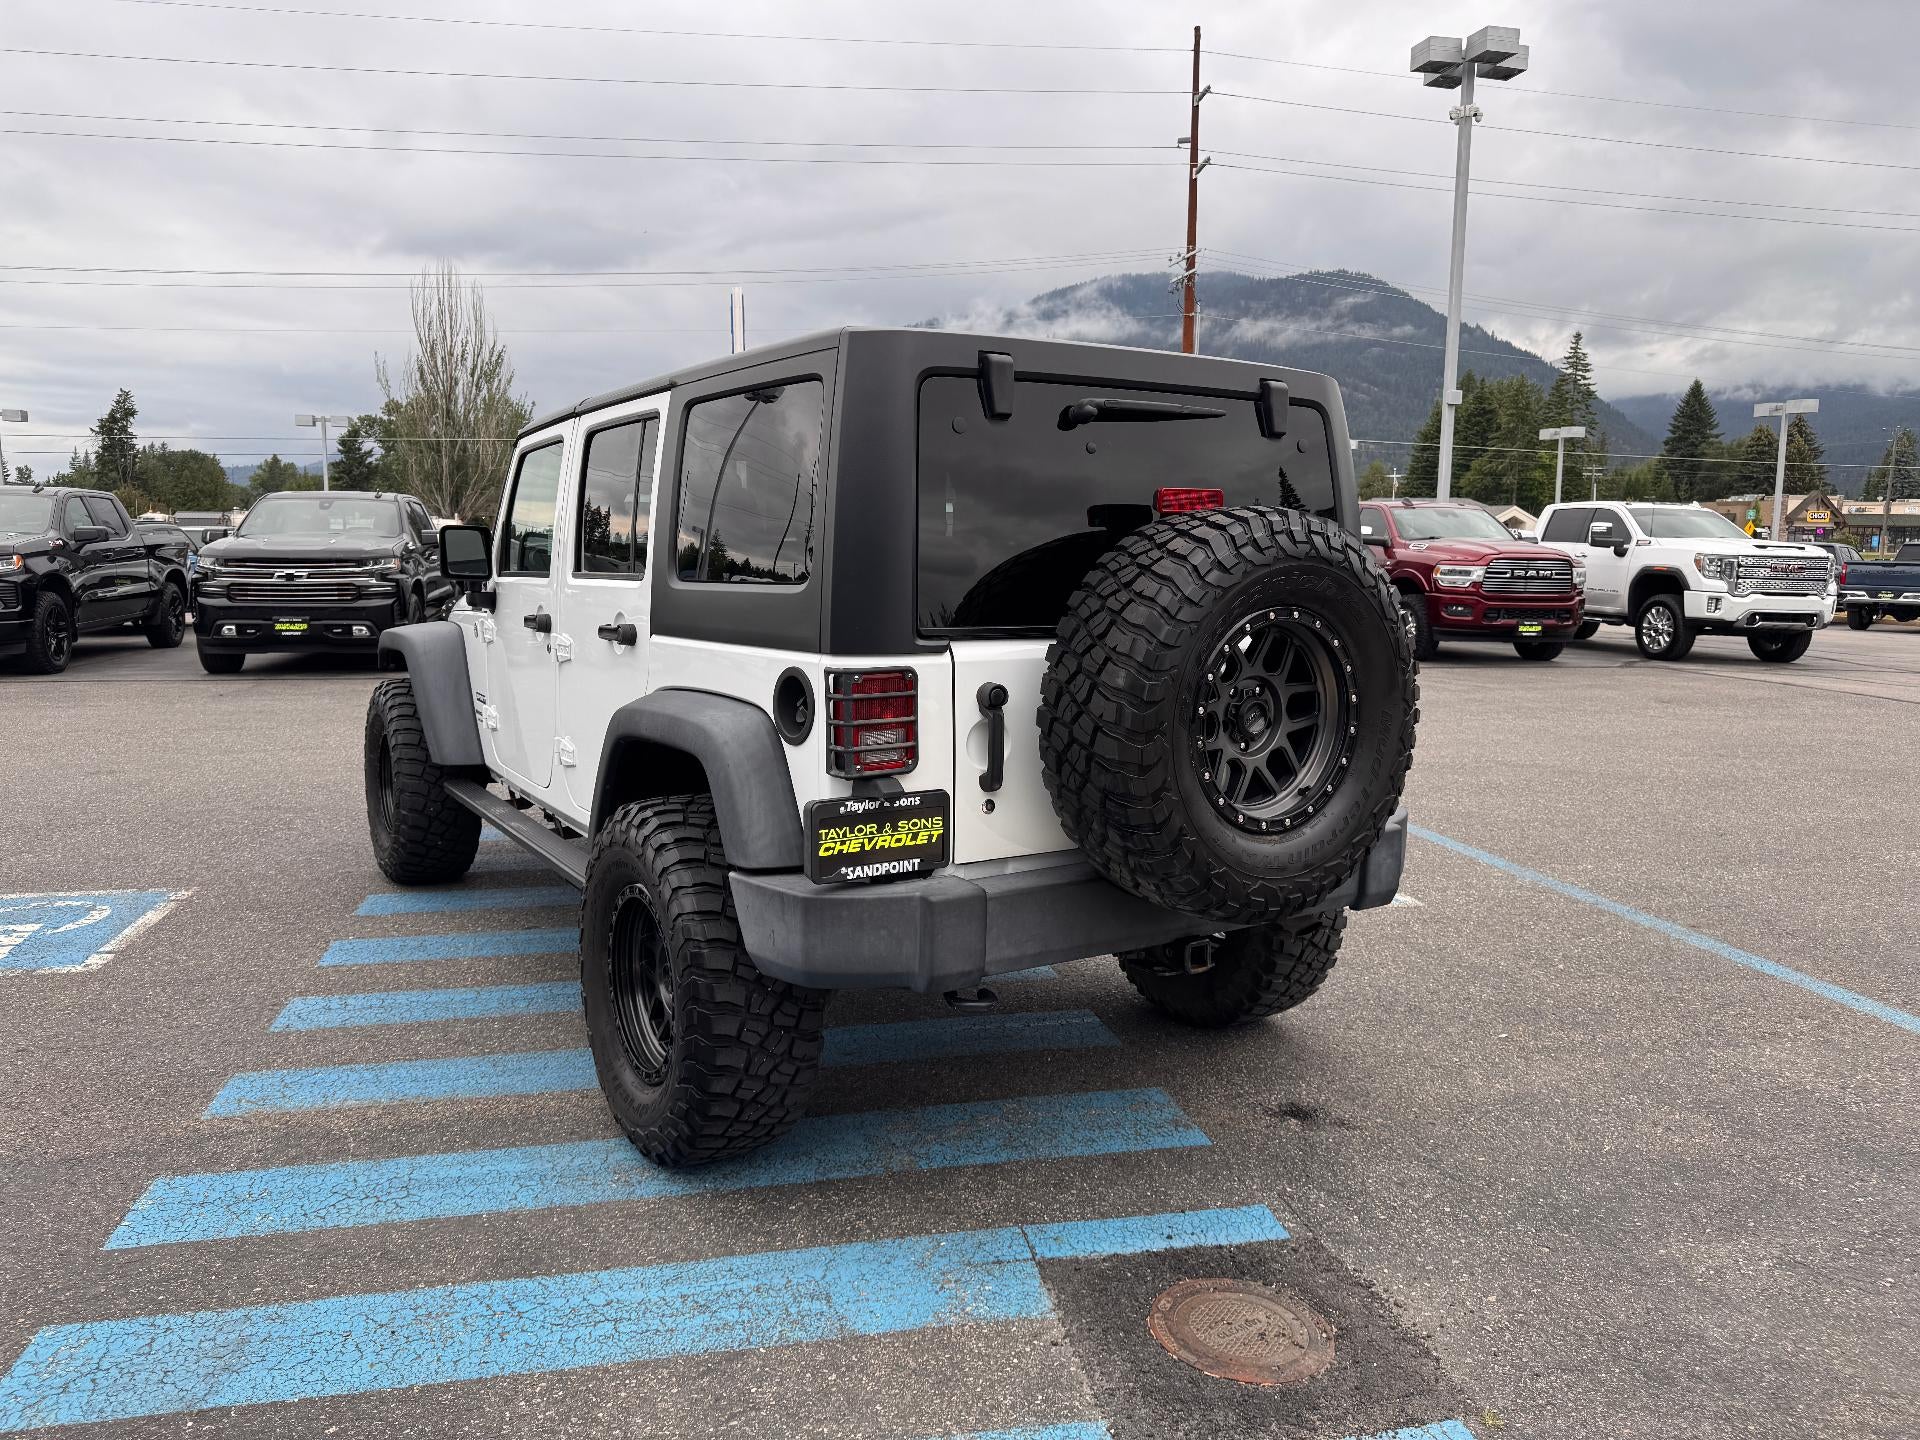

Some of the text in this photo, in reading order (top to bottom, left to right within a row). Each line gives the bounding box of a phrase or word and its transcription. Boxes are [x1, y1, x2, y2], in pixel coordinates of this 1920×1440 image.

[1771, 563, 1805, 572] GMC
[819, 817, 943, 840] TAYLOR & SONS
[818, 830, 943, 857] CHEVROLET
[846, 859, 921, 879] SANDPOINT
